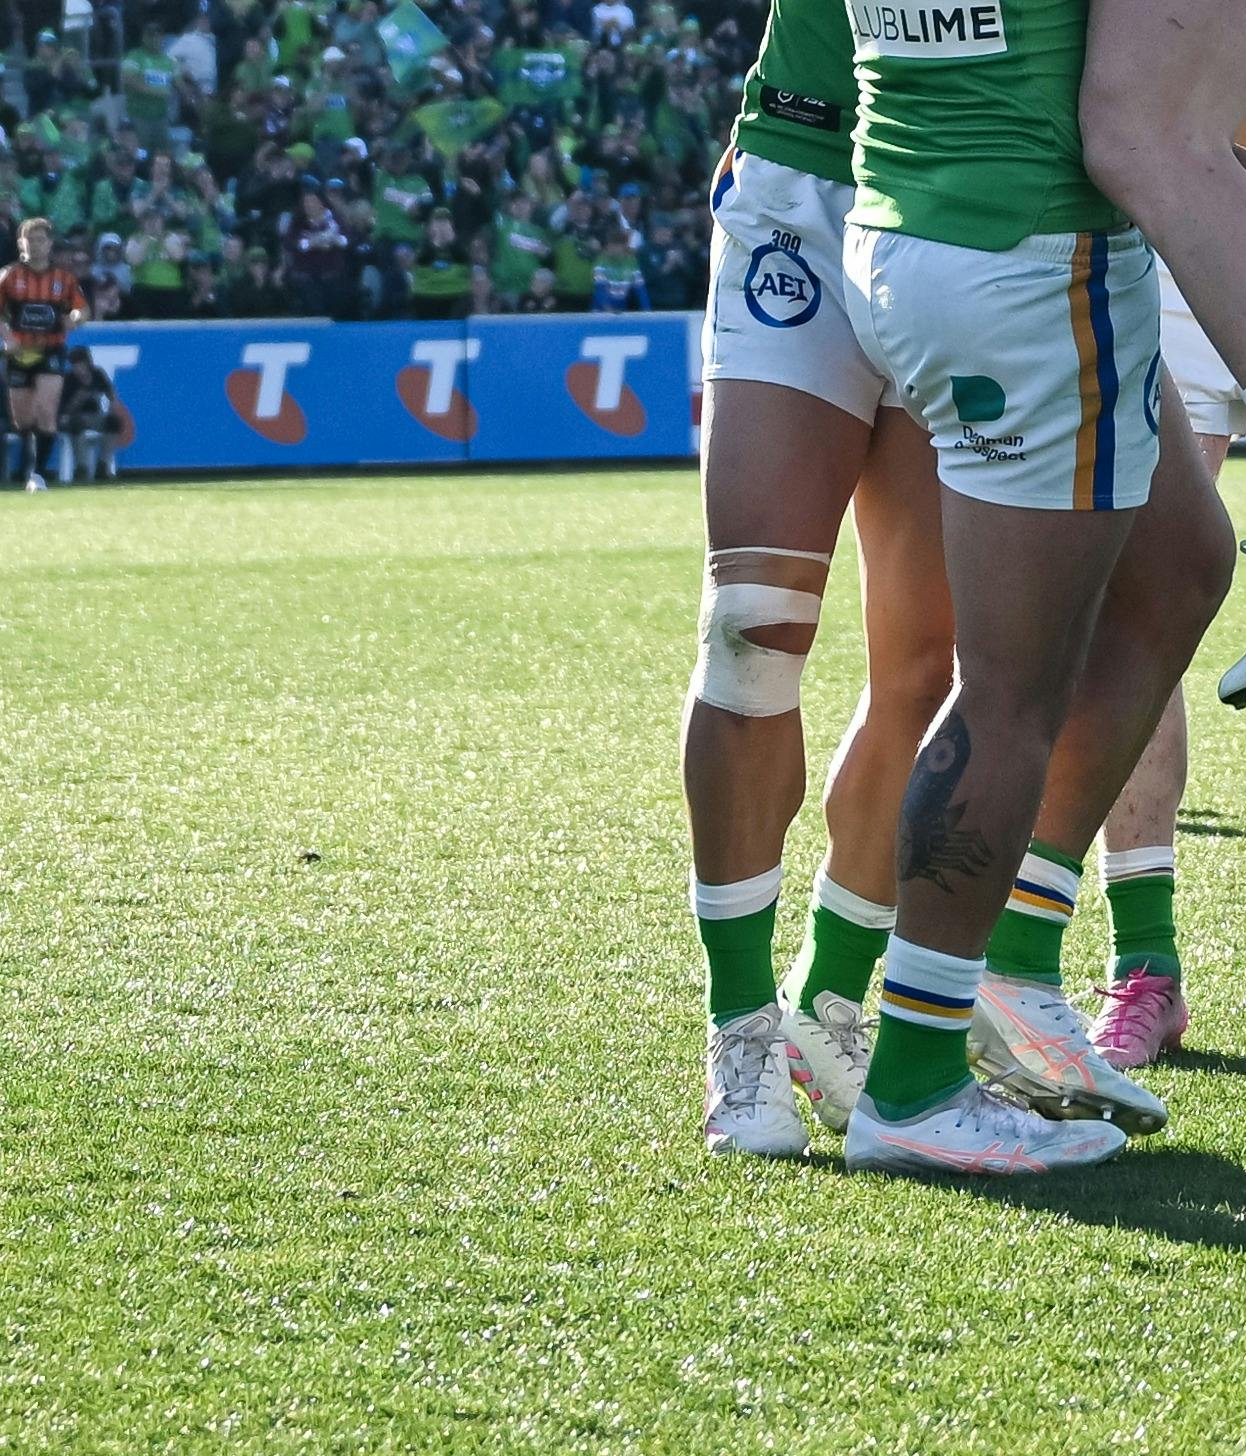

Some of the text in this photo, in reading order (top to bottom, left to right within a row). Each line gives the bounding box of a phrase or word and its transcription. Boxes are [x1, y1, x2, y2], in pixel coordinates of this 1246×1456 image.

[852, 5, 1000, 43] LUBLIME
[757, 272, 808, 304] AEI
[241, 343, 311, 419] T
[412, 339, 481, 414] T
[580, 335, 648, 411] T
